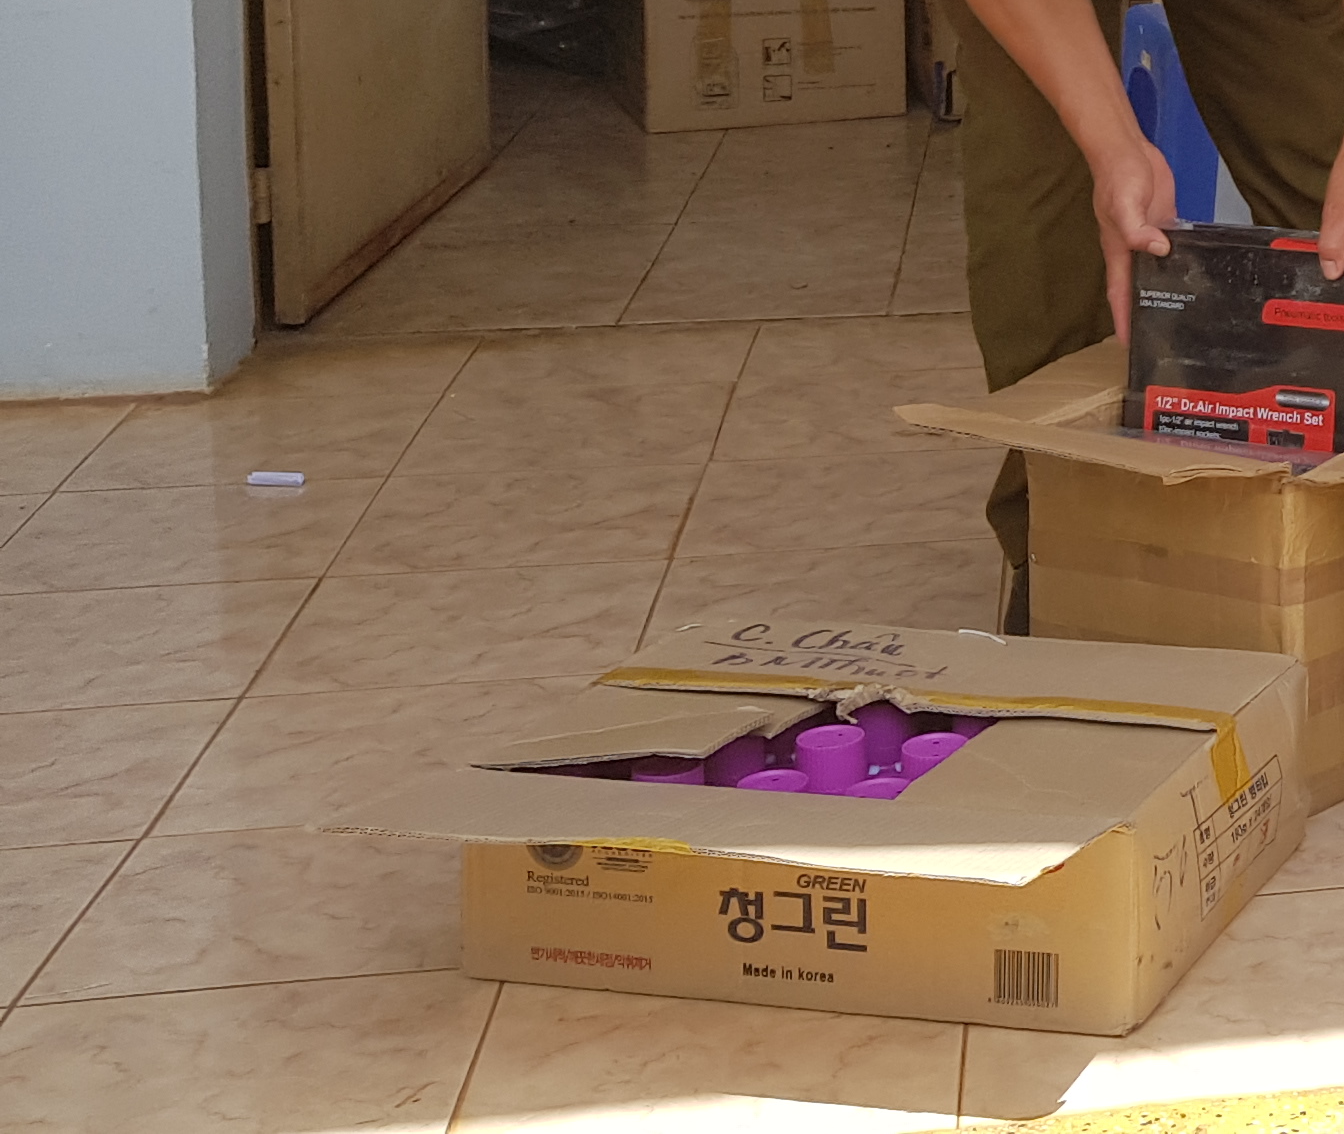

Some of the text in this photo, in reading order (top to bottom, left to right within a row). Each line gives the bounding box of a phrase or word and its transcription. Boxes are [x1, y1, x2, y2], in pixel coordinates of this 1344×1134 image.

[1140, 289, 1196, 302] SUPERIOR QUALITY
[1155, 395, 1179, 409] 1/2"
[1215, 405, 1254, 418] Impact
[1256, 408, 1301, 423] Wrench
[1304, 412, 1324, 426] Set
[527, 870, 590, 887] Registered
[796, 873, 867, 894] GREEN
[527, 886, 543, 894] ISO
[718, 887, 868, 953] 청그린
[742, 962, 835, 984] Made in korea
